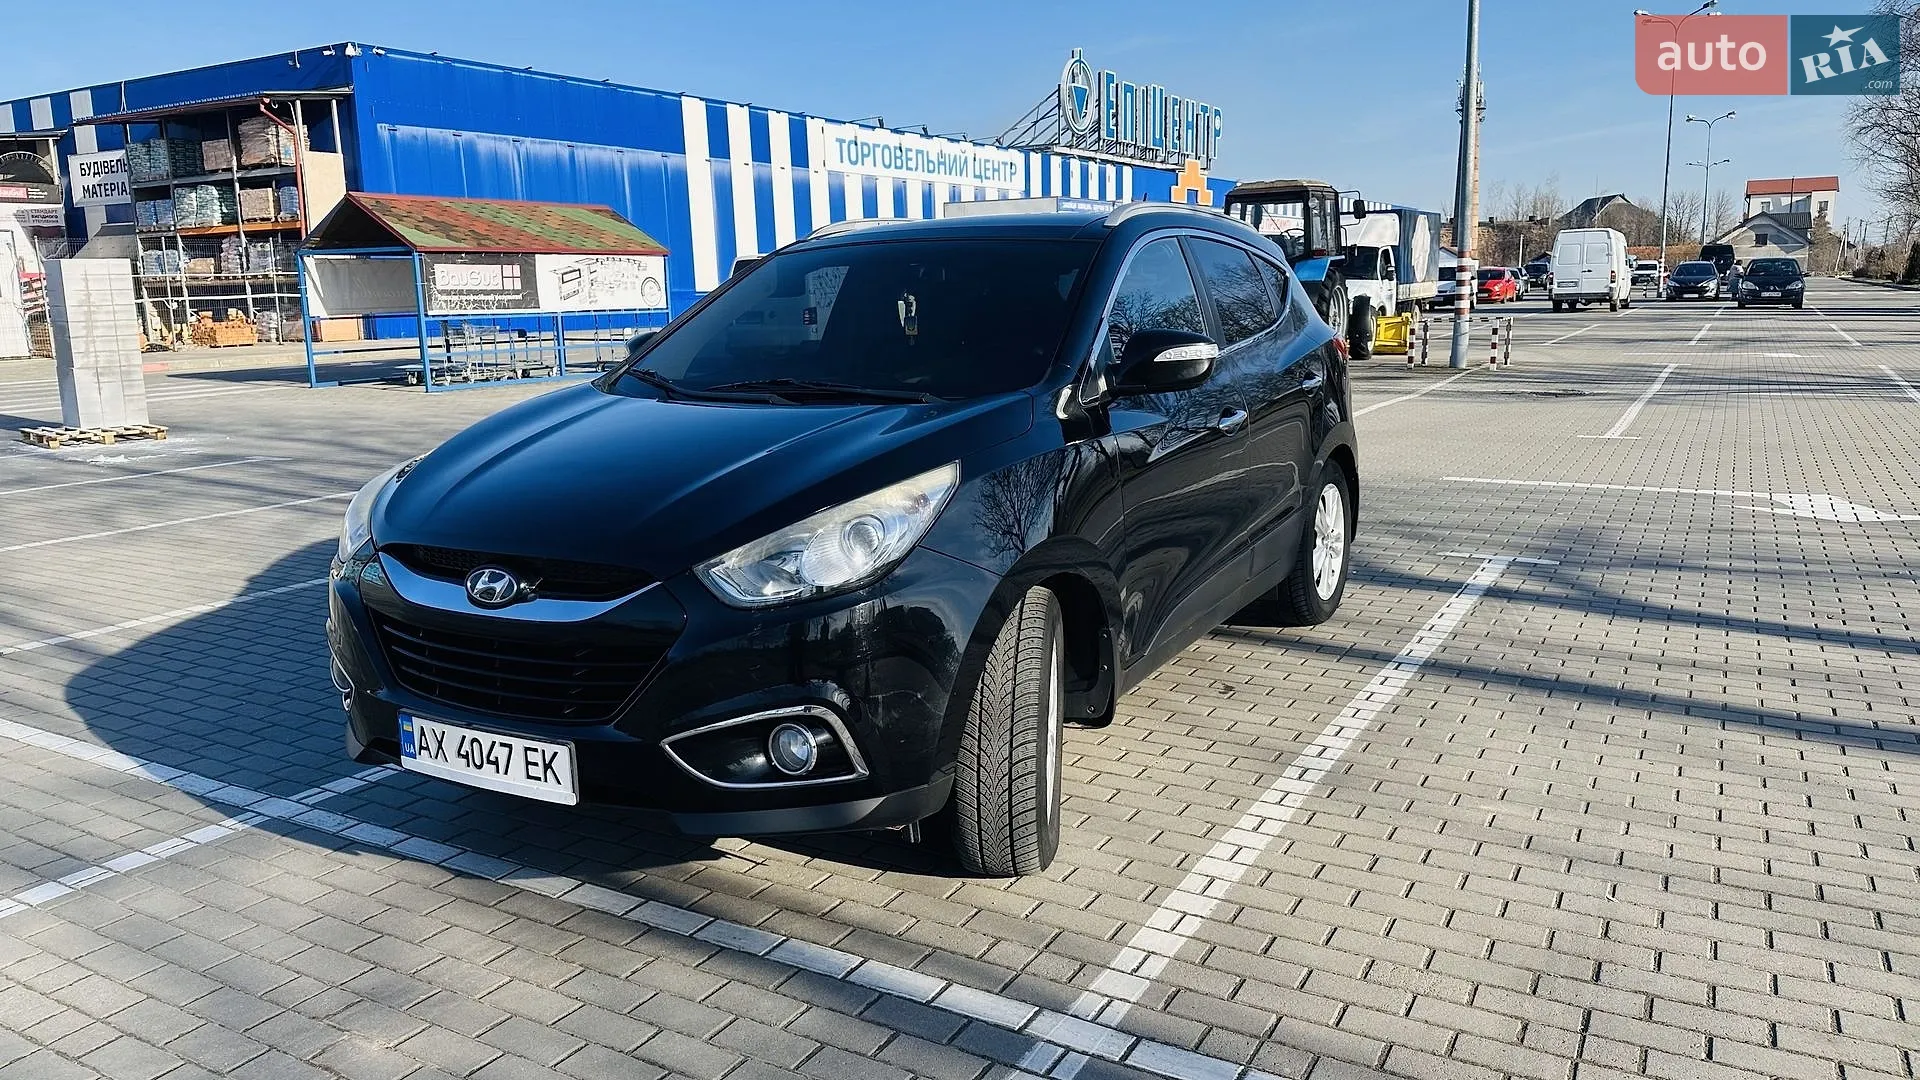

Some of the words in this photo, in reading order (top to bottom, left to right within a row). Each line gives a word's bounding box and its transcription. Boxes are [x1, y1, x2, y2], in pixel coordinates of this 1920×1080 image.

[1102, 70, 1223, 159] ЕПІЦЕНТР
[835, 137, 968, 178] ТОРГОВЕЛЬНИЙ
[972, 157, 1017, 183] ЦЕНТР
[82, 181, 130, 199] МАТЕРІА
[439, 269, 499, 287] BauGut
[404, 743, 415, 754] UA
[418, 725, 449, 763] AX
[457, 735, 513, 776] 4047
[524, 746, 562, 785] EK
